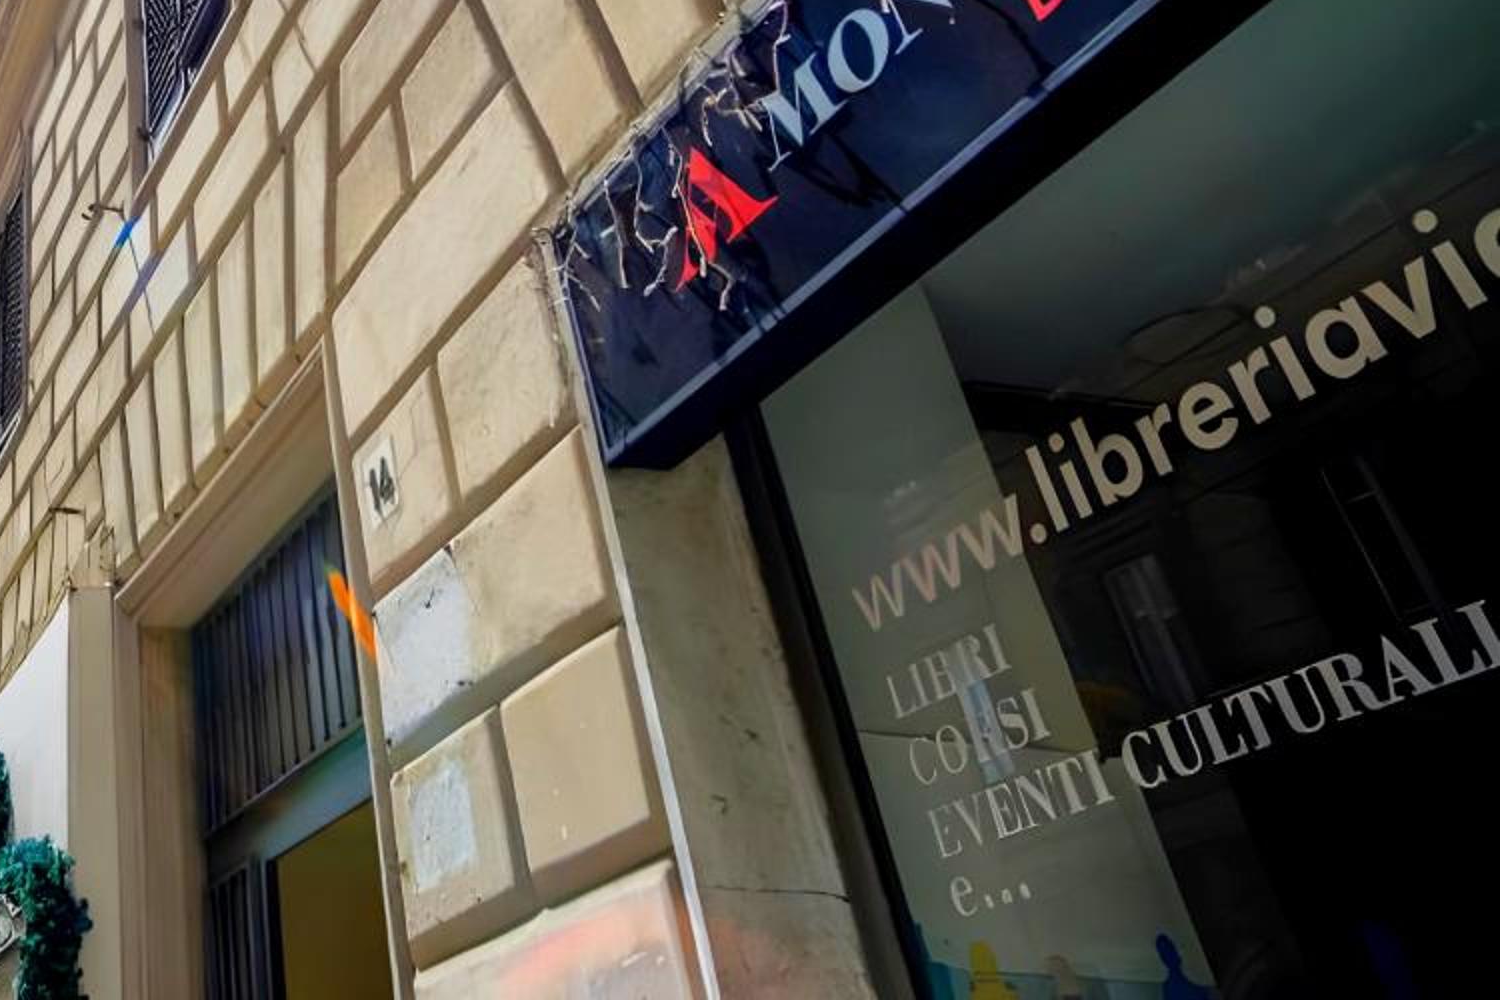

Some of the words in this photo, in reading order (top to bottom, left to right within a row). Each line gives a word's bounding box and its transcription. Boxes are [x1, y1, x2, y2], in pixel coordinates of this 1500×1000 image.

[886, 622, 1012, 718] LIBRI
[909, 687, 1051, 785] CORSI
[928, 749, 1116, 859] EVENTI
[1121, 599, 1500, 790] CULTURALI
